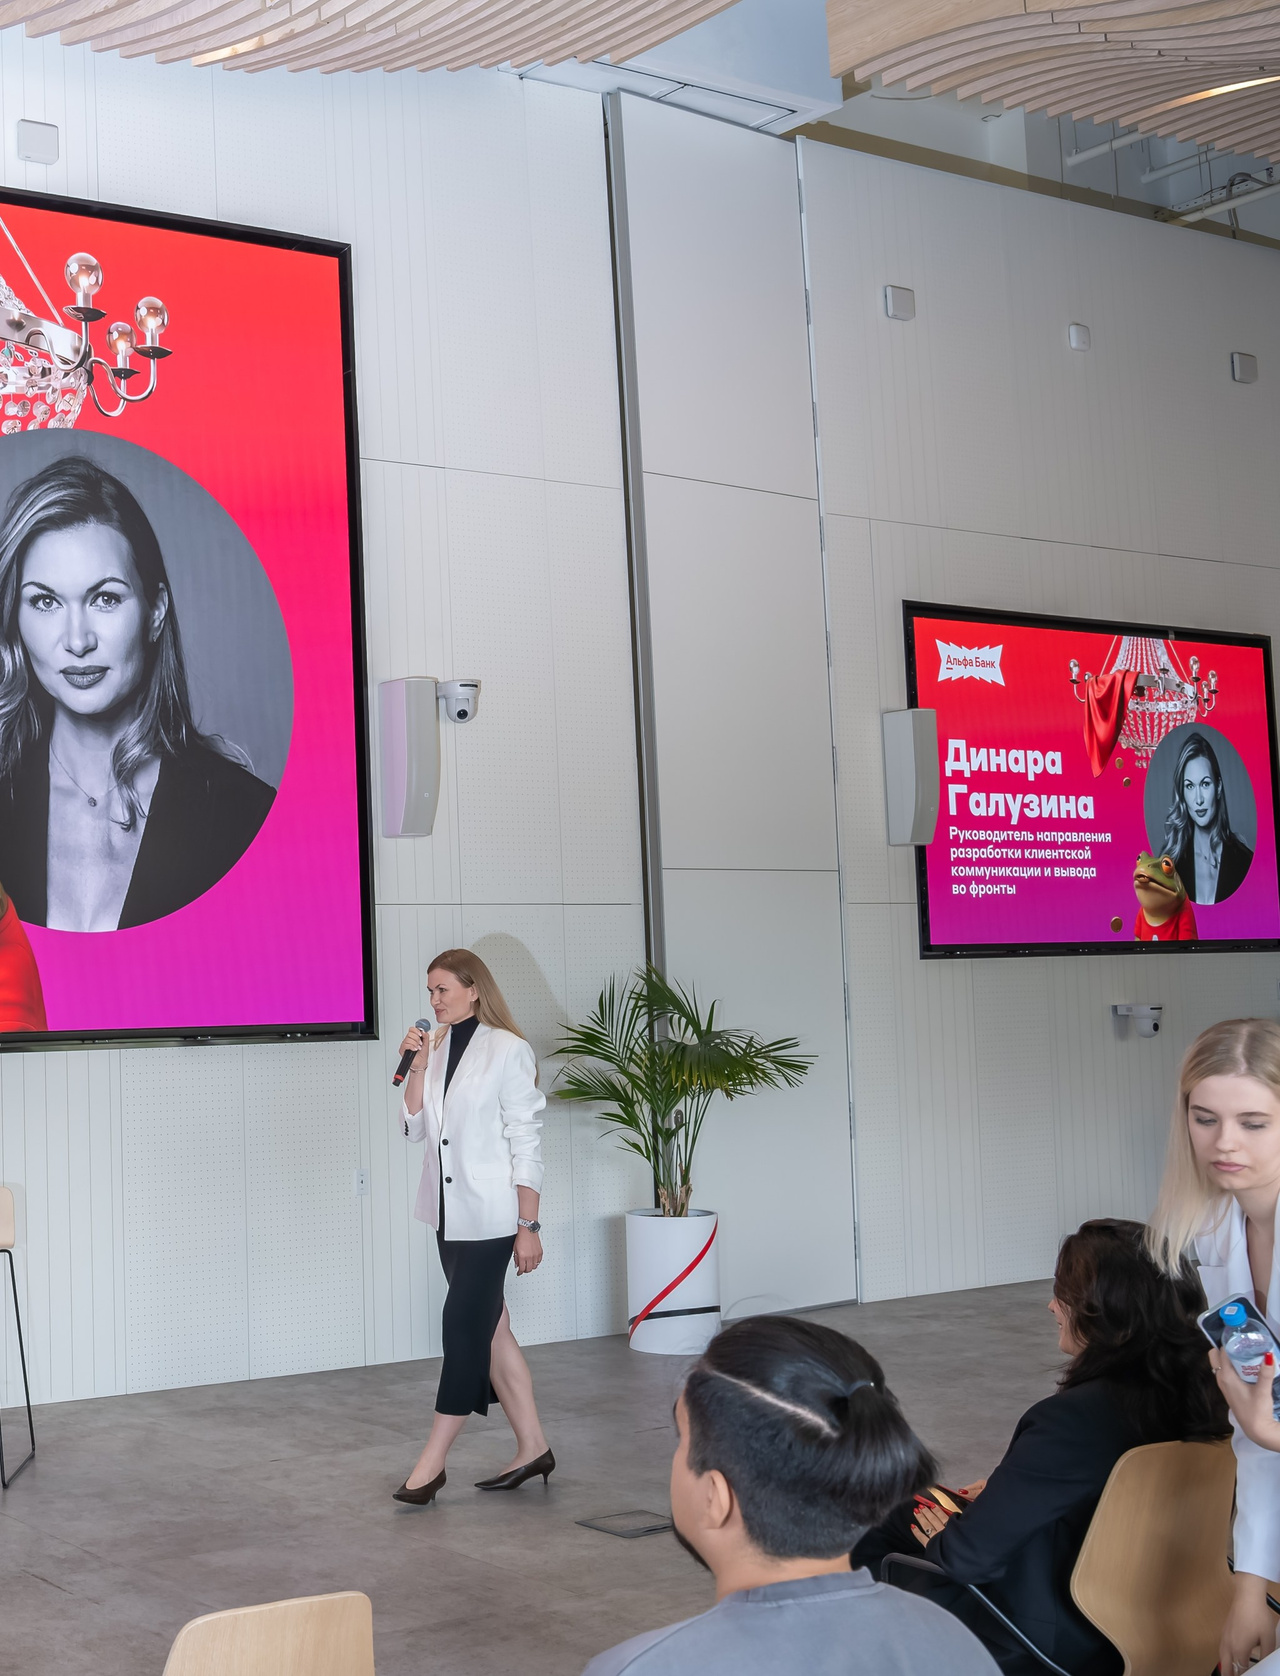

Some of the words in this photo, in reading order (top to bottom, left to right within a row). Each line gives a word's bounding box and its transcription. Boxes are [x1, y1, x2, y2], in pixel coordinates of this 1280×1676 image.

[946, 654, 973, 670] Альфа
[975, 657, 996, 669] Банк
[945, 739, 1062, 781] Динара
[948, 784, 1094, 825] Галузина
[949, 826, 1034, 843] Руководитель
[1036, 831, 1112, 845] направления
[950, 845, 1022, 861] разработки
[1024, 846, 1091, 860] клиентской
[951, 866, 1041, 880] коммуникации
[1044, 867, 1051, 877] и
[1054, 867, 1096, 879] вывода
[952, 884, 967, 895] во
[969, 880, 1016, 898] фронты
